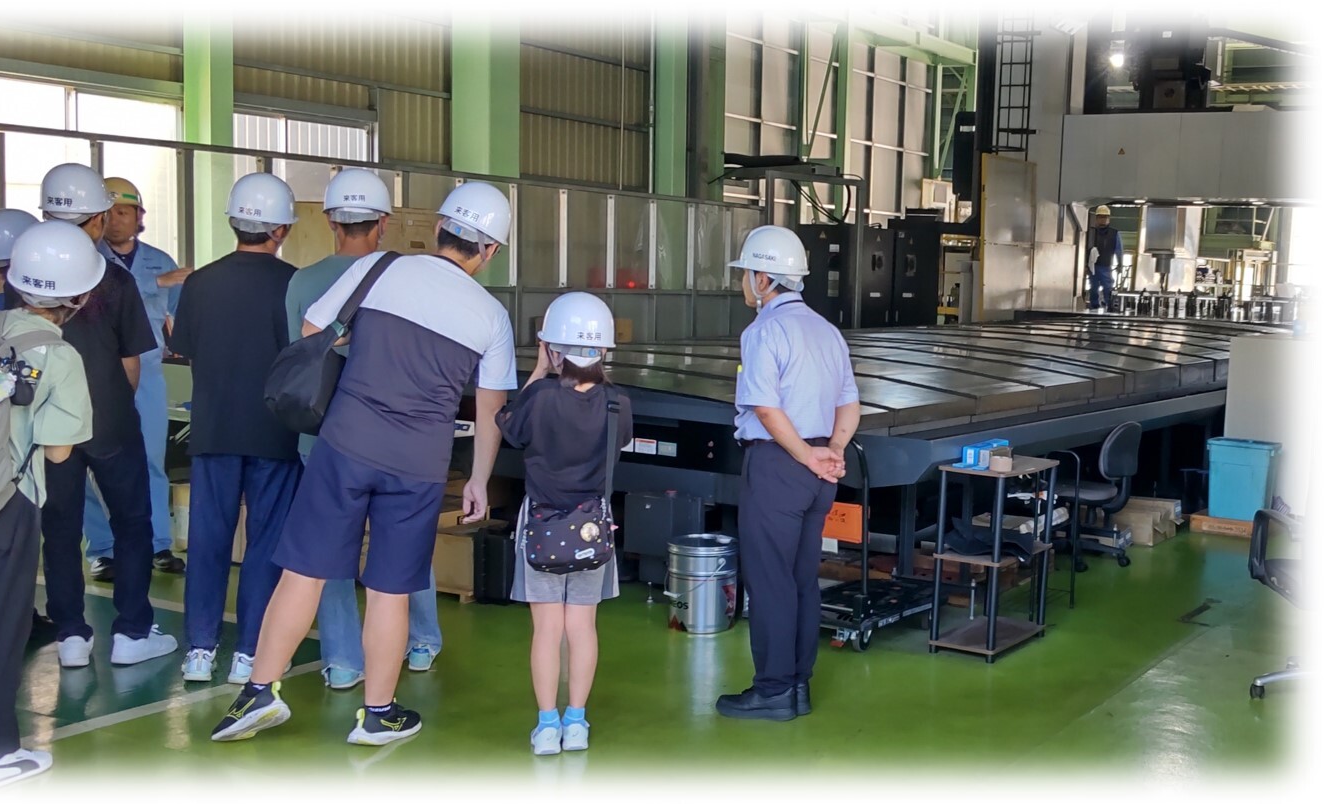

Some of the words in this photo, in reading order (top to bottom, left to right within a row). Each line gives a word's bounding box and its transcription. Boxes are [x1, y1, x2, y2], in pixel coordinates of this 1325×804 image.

[46, 196, 73, 207] 来客用
[343, 194, 366, 202] 来客用
[238, 206, 262, 217] 来客用
[454, 206, 480, 222] 来客用
[21, 275, 56, 290] 来客用
[576, 331, 602, 341] 来客用
